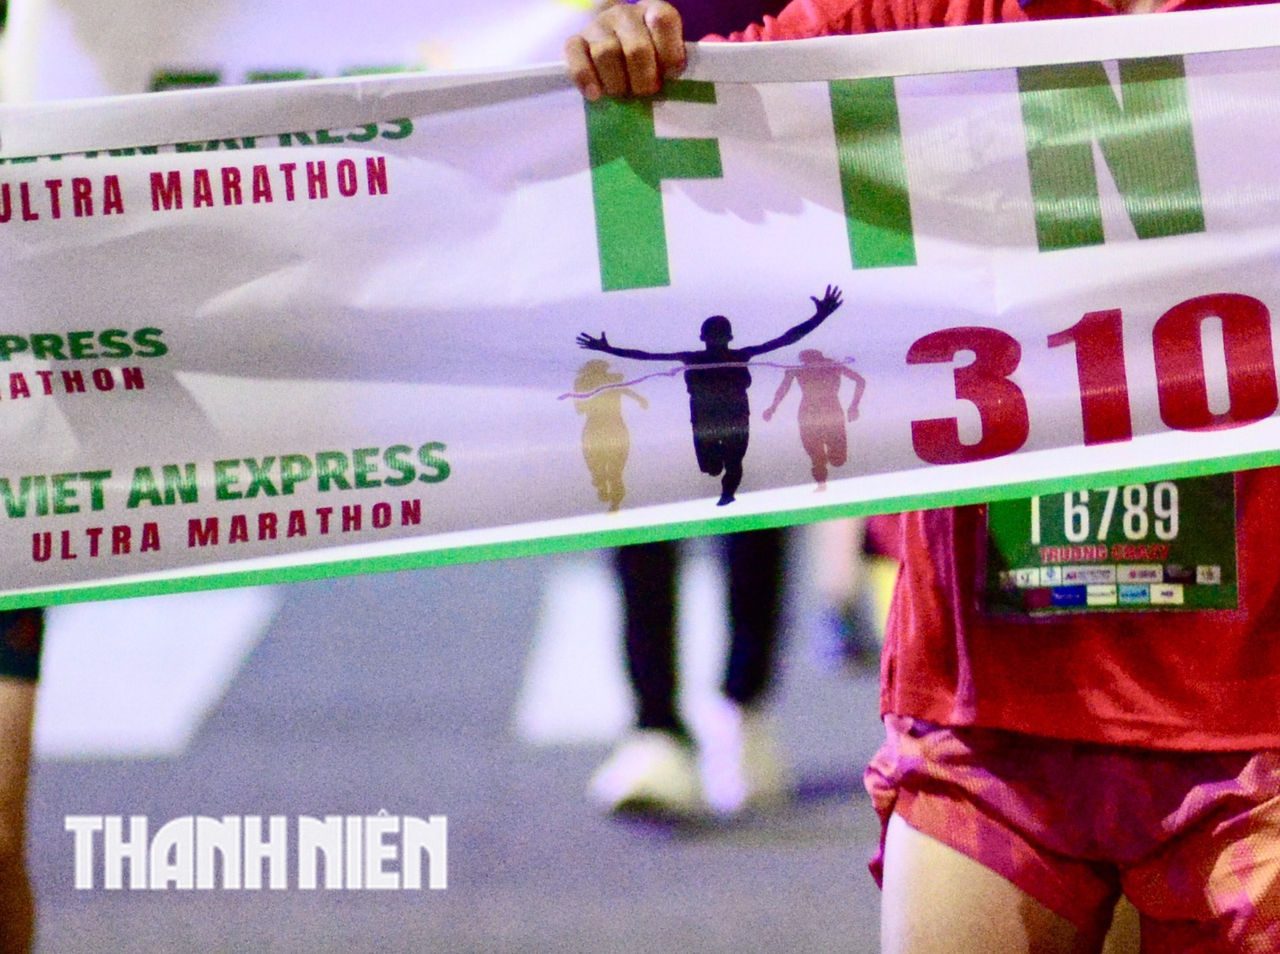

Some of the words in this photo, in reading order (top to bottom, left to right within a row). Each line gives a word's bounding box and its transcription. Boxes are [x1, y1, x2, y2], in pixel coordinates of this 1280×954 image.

[150, 156, 389, 211] MARATHON
[902, 292, 1279, 467] 310
[0, 469, 112, 518] VIET
[126, 462, 199, 509] AN
[213, 441, 452, 502] EXPRESS
[32, 521, 160, 563] ULTRA
[188, 499, 422, 548] MARATHON
